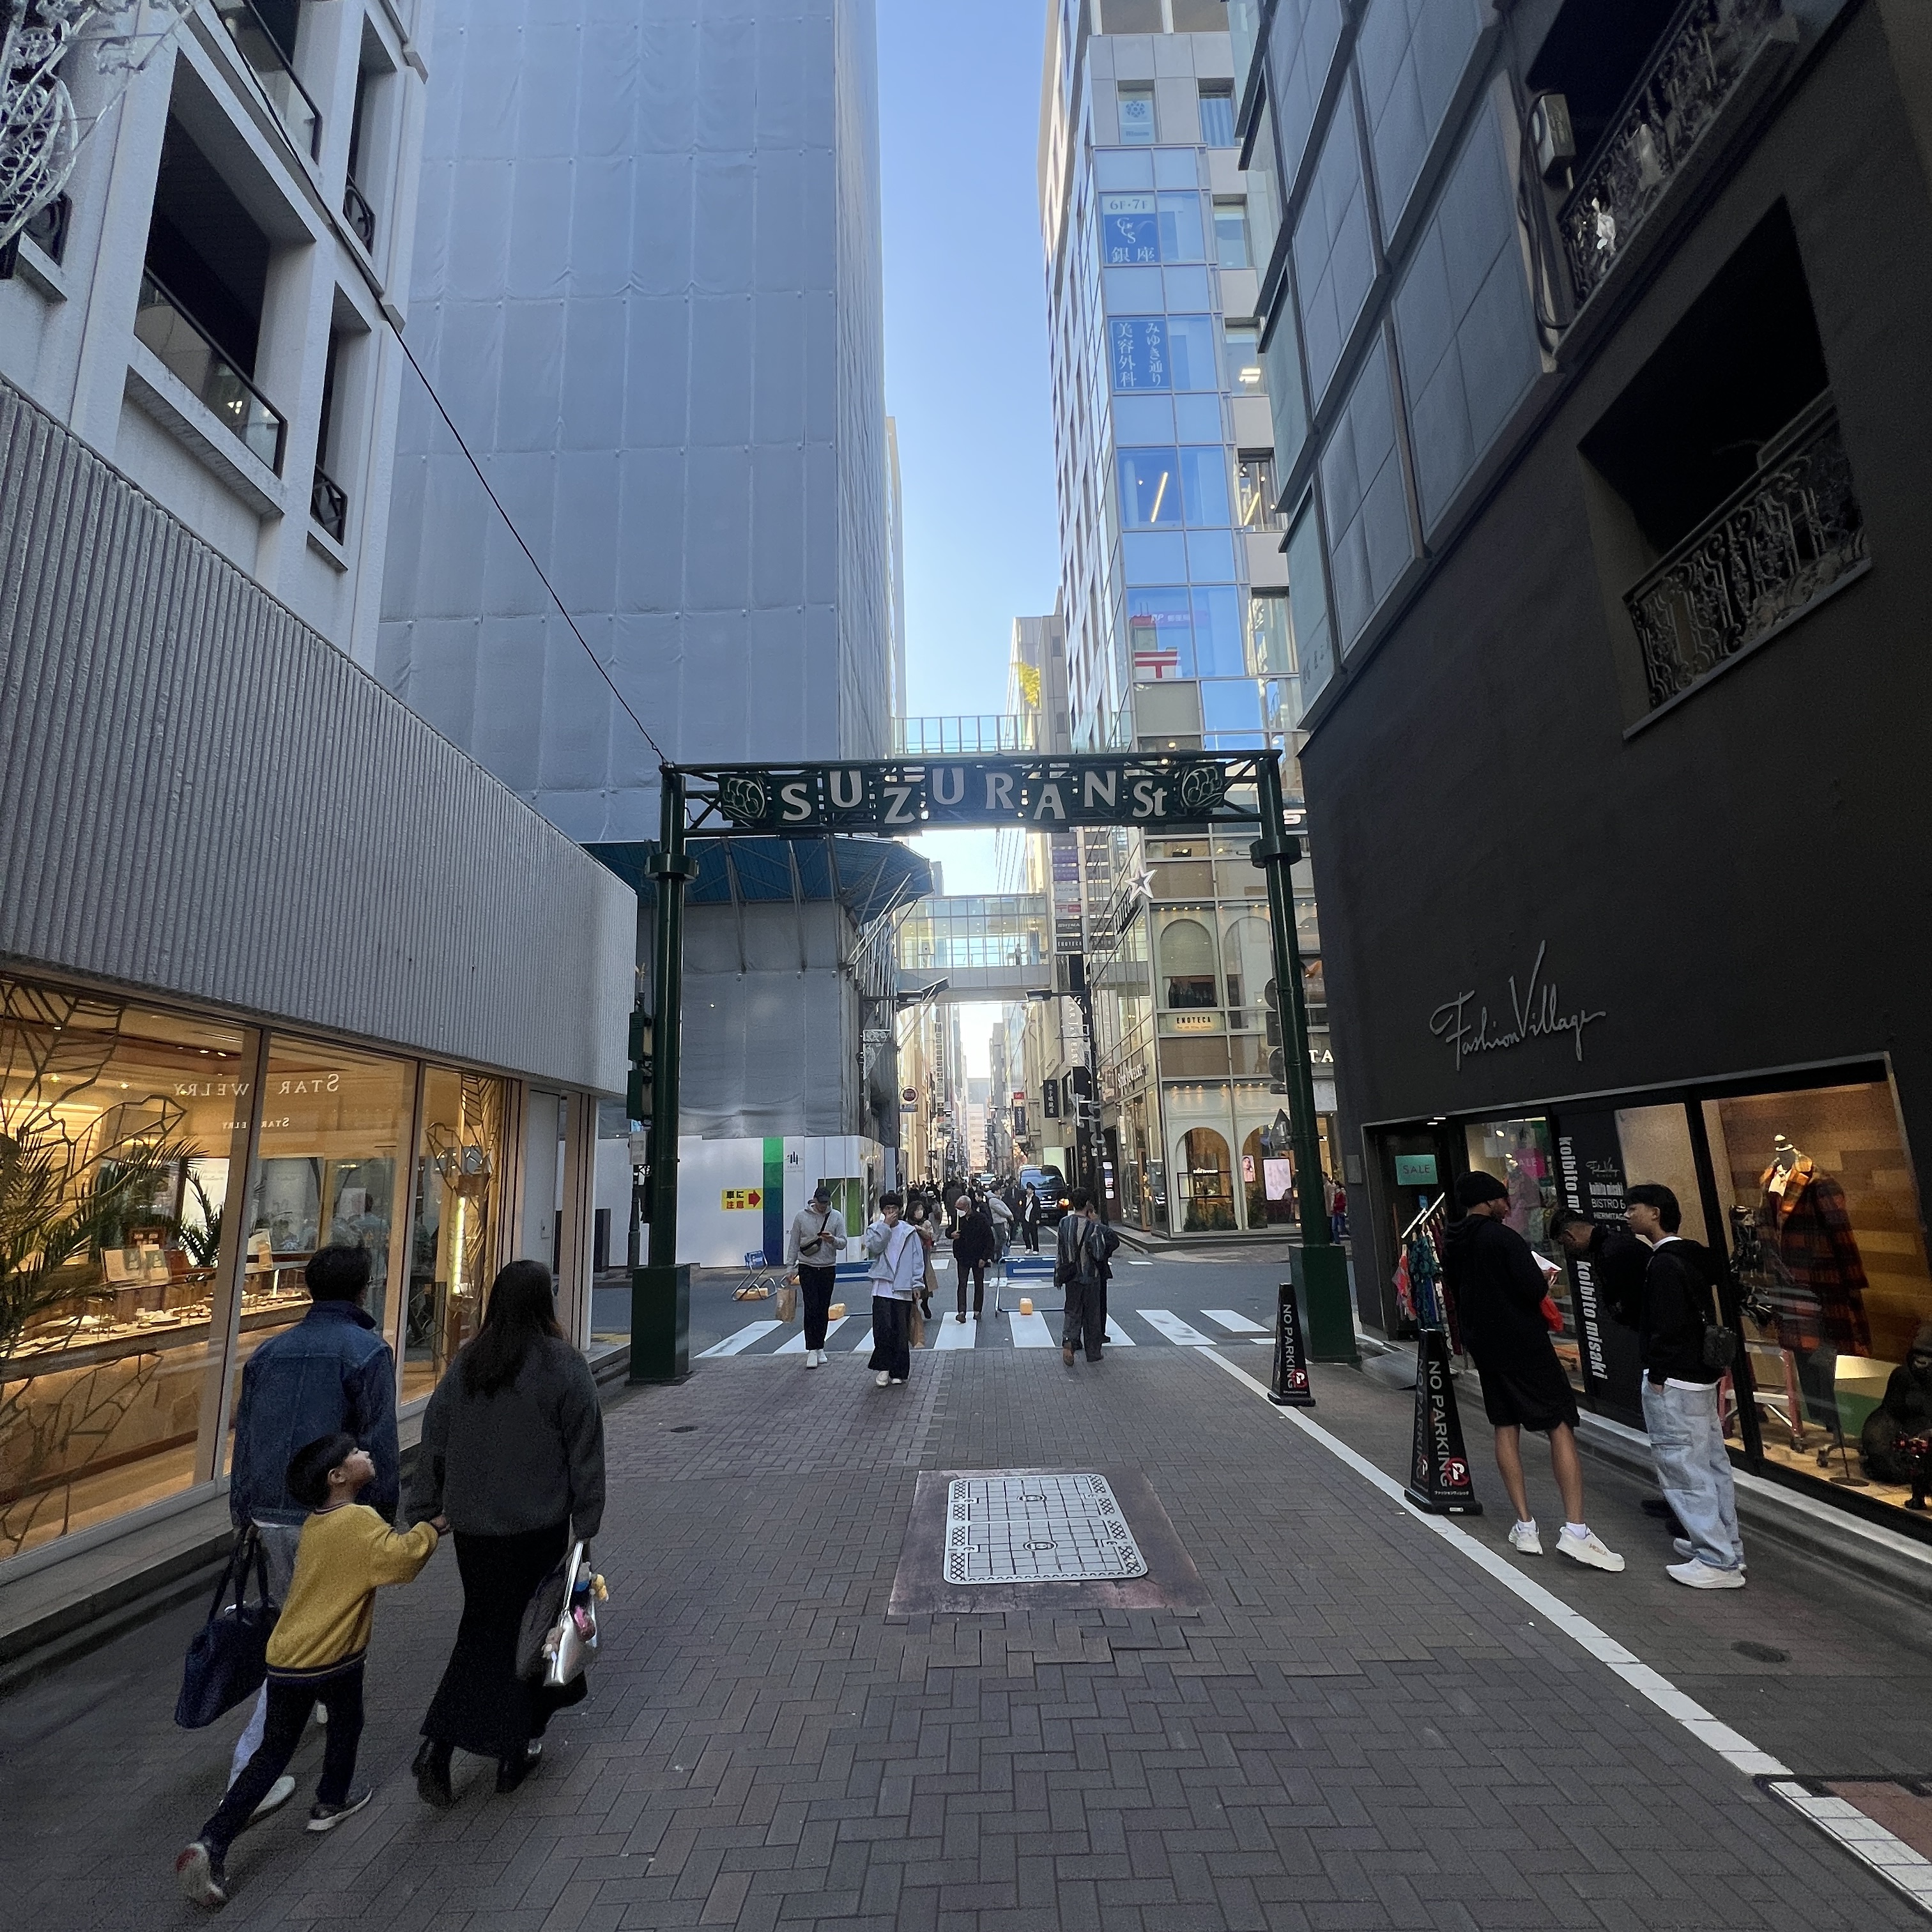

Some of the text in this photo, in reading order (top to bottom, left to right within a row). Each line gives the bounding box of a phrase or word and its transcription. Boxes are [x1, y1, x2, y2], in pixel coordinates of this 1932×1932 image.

[1112, 247, 1155, 263] 銀座
[1117, 323, 1137, 387] 美容外科
[1146, 323, 1163, 387] みゆき通り
[781, 769, 1167, 824] SUZURAN St
[1430, 939, 1607, 1071] Fashion Village
[1308, 1049, 1334, 1063] TA
[1402, 1165, 1430, 1174] SALE
[1519, 1157, 1538, 1168] ALE
[1559, 1137, 1579, 1190] koibito
[726, 1200, 744, 1209] 注意
[1591, 1198, 1619, 1209] BISTRO
[1283, 1304, 1292, 1324] NO
[1576, 1260, 1609, 1380] koibito misaki
[1284, 1327, 1296, 1388] PARKING
[1429, 1361, 1453, 1487] NO PARKING
